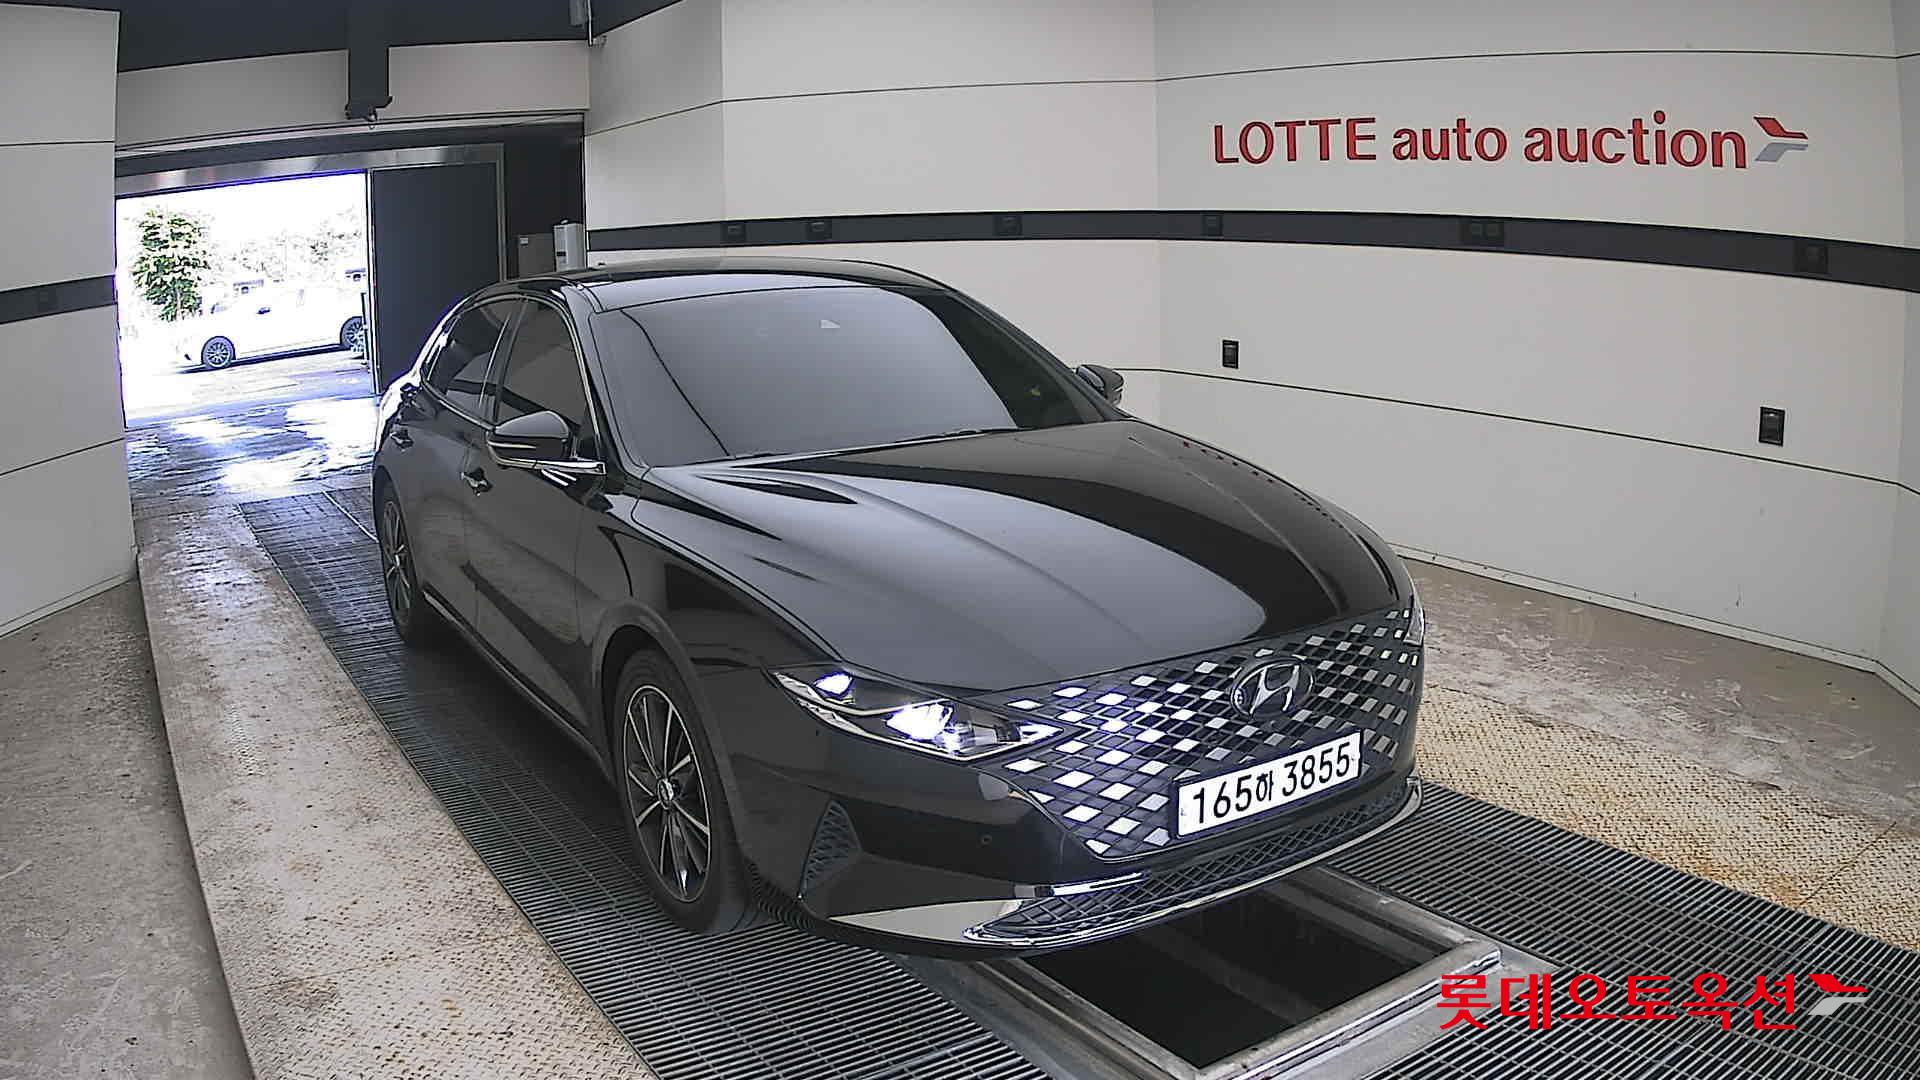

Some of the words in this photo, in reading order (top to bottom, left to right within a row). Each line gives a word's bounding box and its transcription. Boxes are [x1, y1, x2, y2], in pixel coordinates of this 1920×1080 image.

[1213, 117, 1377, 165] LOTTE
[1392, 117, 1508, 162] auto
[1523, 110, 1748, 169] auction
[1282, 741, 1350, 796] 3855
